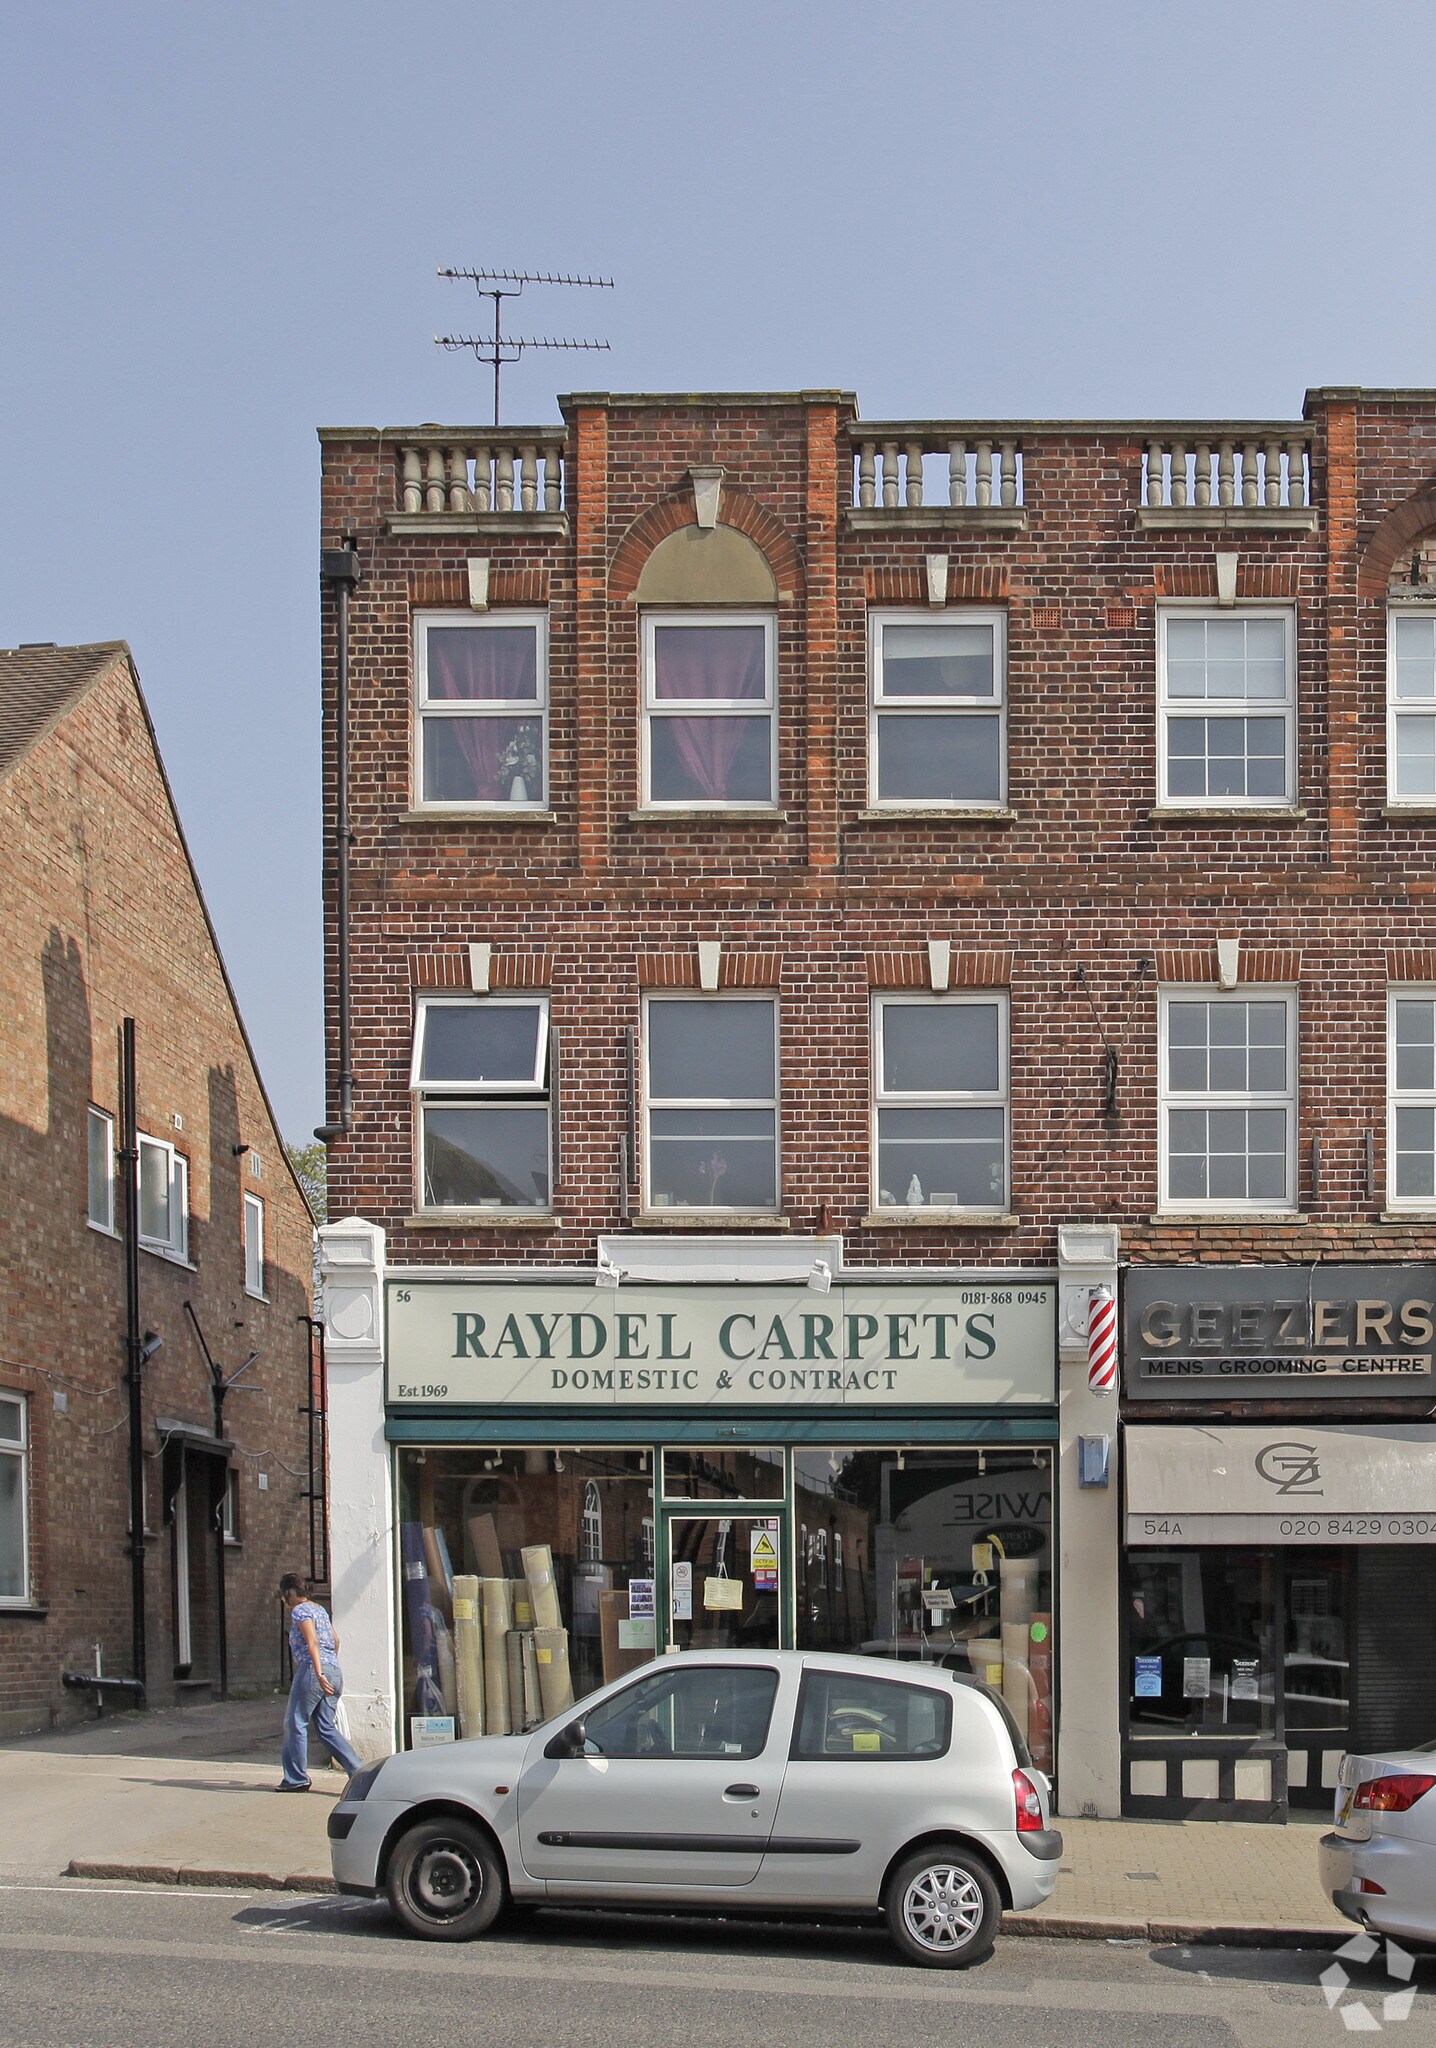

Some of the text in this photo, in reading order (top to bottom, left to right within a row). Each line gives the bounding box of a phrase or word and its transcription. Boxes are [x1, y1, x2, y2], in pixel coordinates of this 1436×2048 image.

[396, 1290, 411, 1303] 56
[961, 1291, 1047, 1305] 0181-868 0945
[1140, 1300, 1435, 1348] GEEZERS
[451, 1312, 997, 1361] RAYDEL CARPETS
[1149, 1358, 1424, 1374] MENS GROOMING CENTRE
[551, 1369, 898, 1390] DOMESTIC & CONTRACT
[1143, 1520, 1183, 1536] 54A
[1279, 1520, 1321, 1536] 020
[1327, 1520, 1382, 1535] 8429
